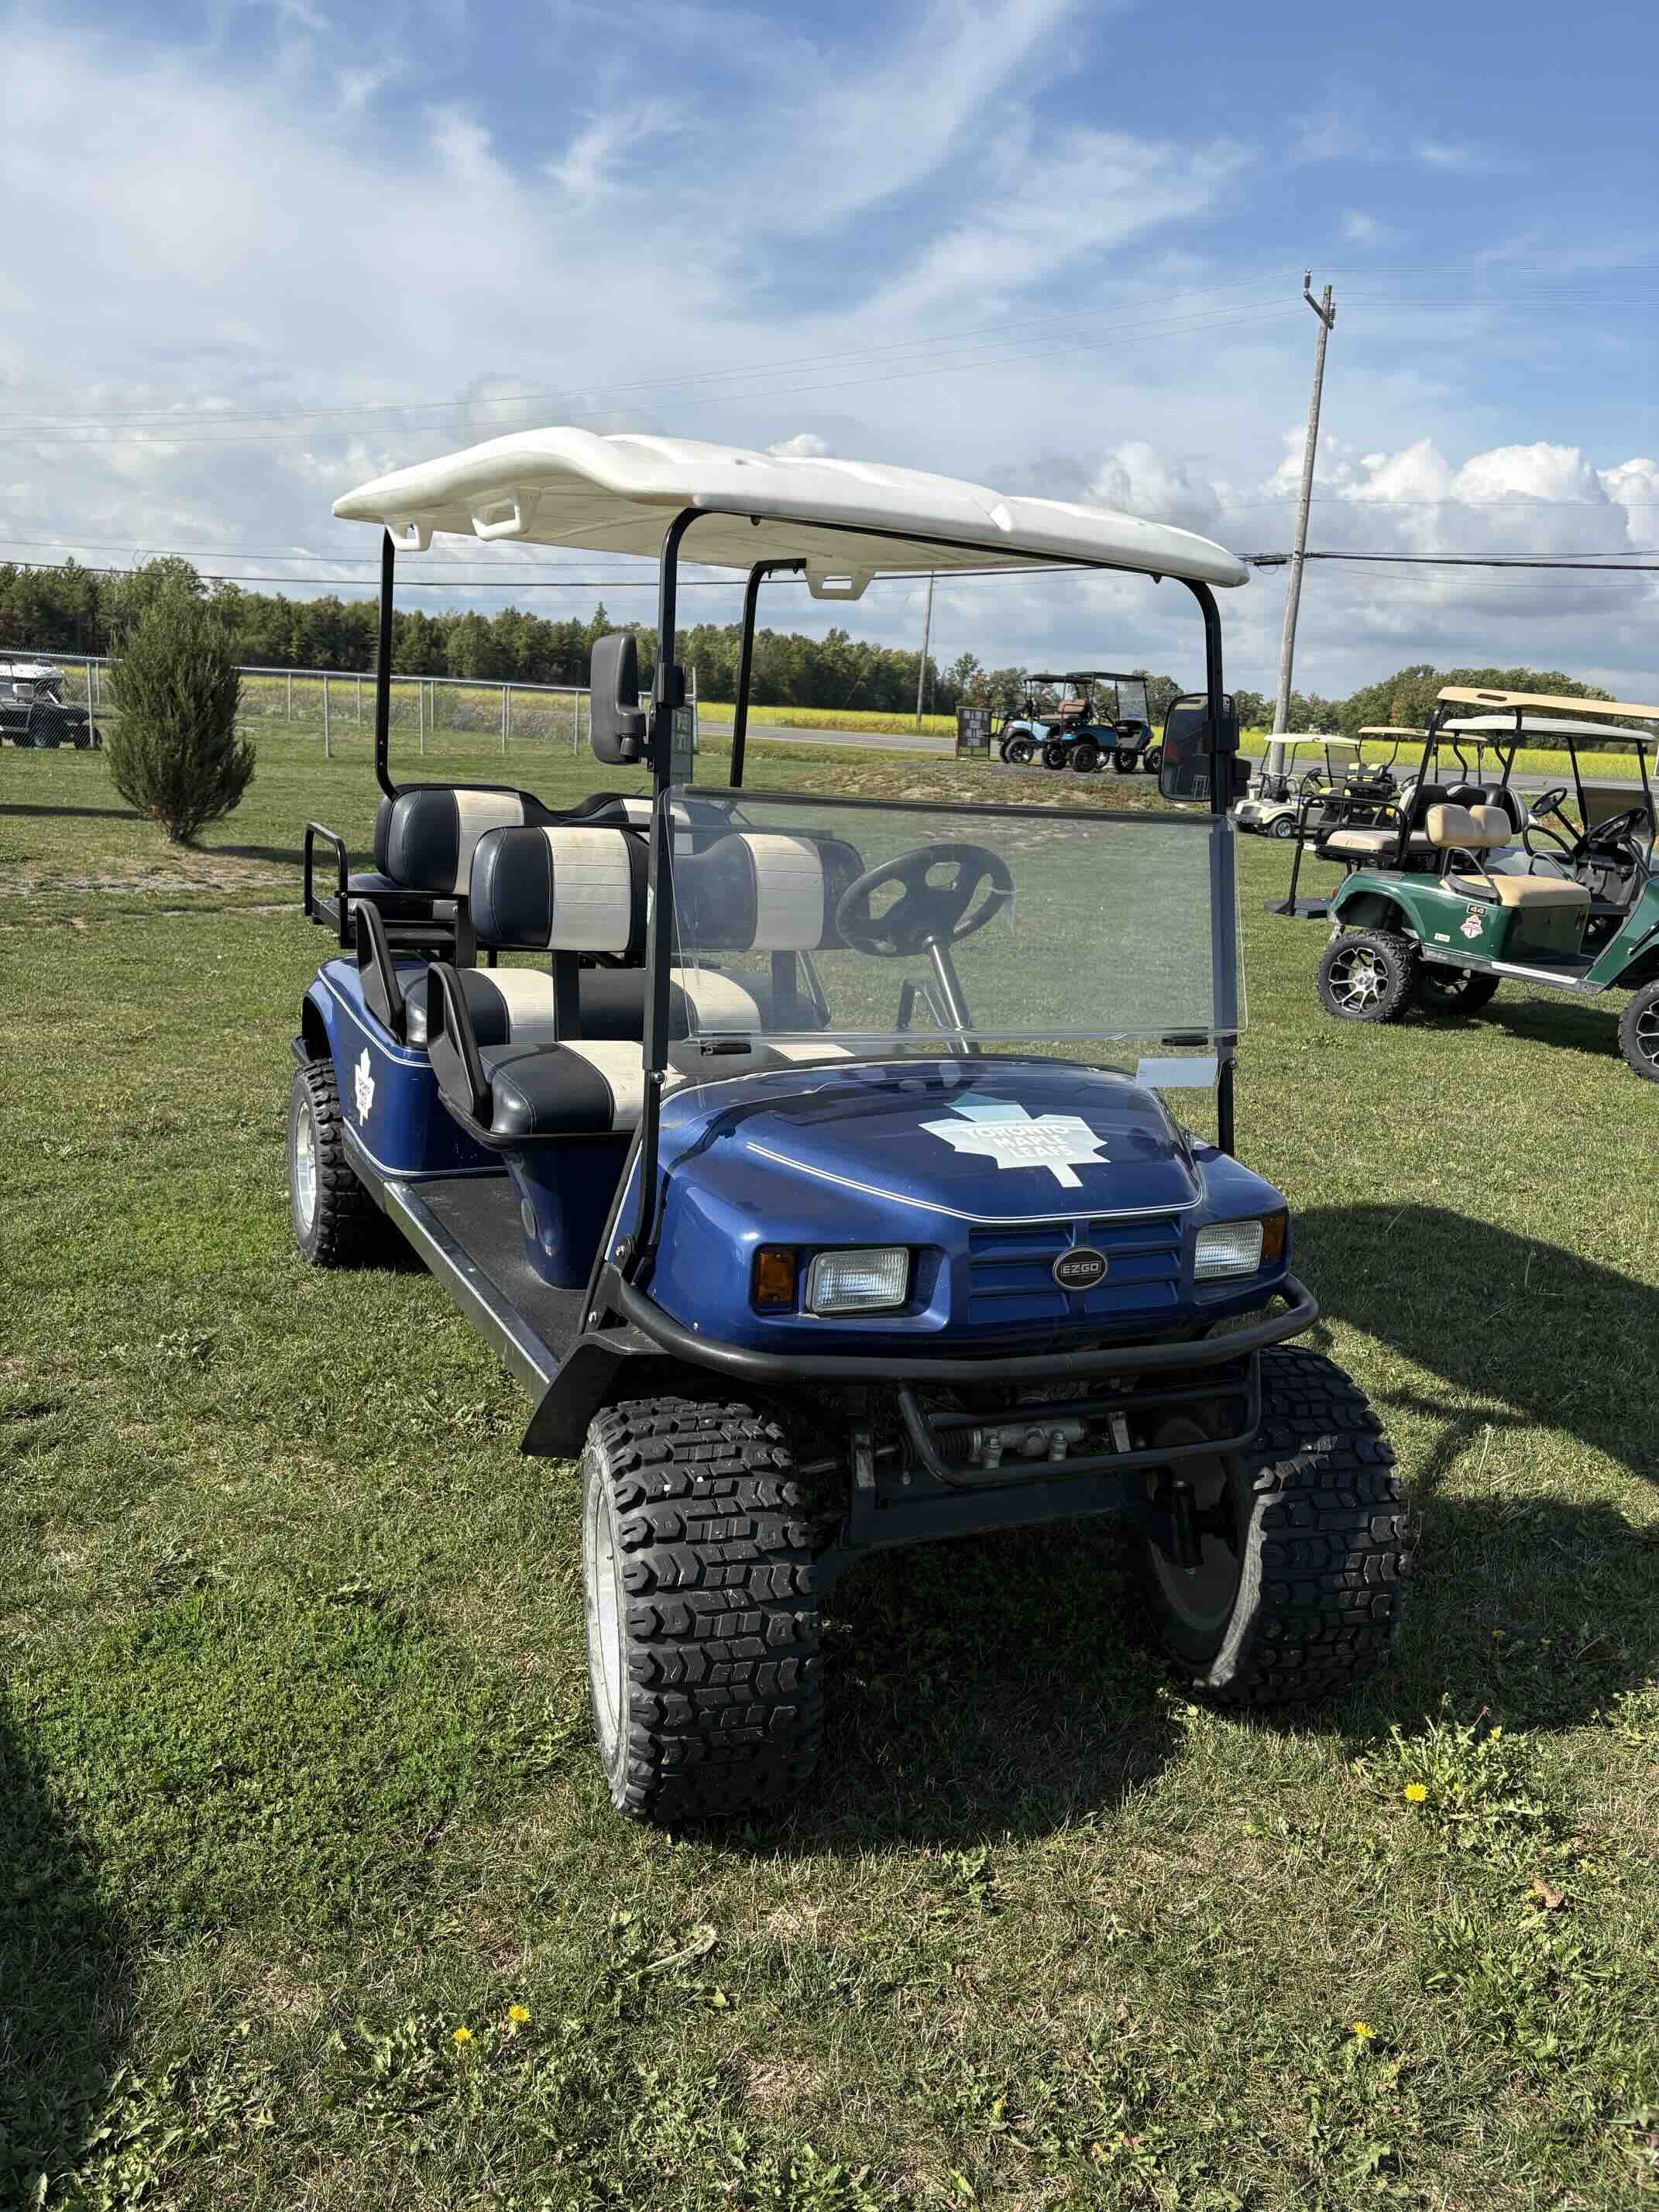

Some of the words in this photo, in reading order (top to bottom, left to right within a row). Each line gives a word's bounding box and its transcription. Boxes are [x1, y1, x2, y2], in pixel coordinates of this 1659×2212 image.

[967, 1125, 1068, 1140] TORONTO
[992, 1135, 1068, 1148] MAPLE
[1009, 1146, 1073, 1159] LEAFS
